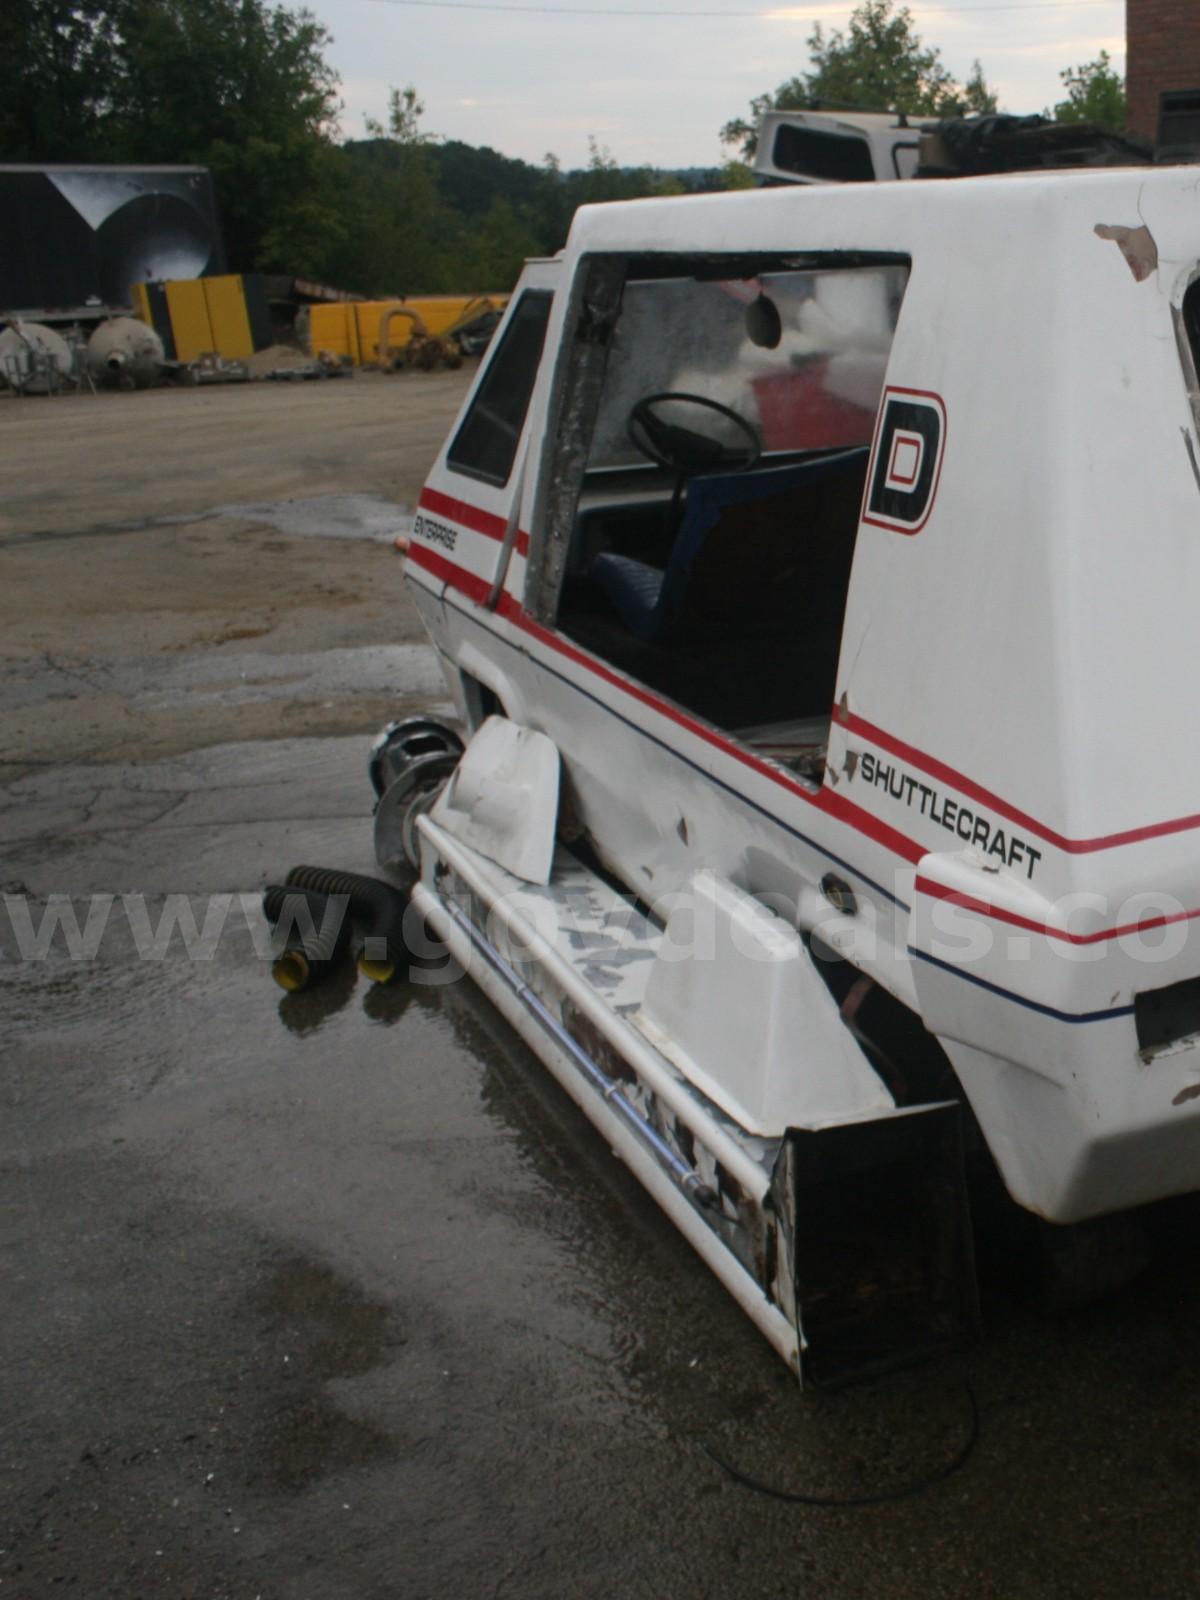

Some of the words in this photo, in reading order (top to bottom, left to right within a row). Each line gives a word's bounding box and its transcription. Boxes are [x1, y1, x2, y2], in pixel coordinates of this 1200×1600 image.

[861, 385, 947, 536] D
[413, 515, 458, 551] ENTERPRISE
[861, 752, 1042, 880] SHUTTLECRAFT
